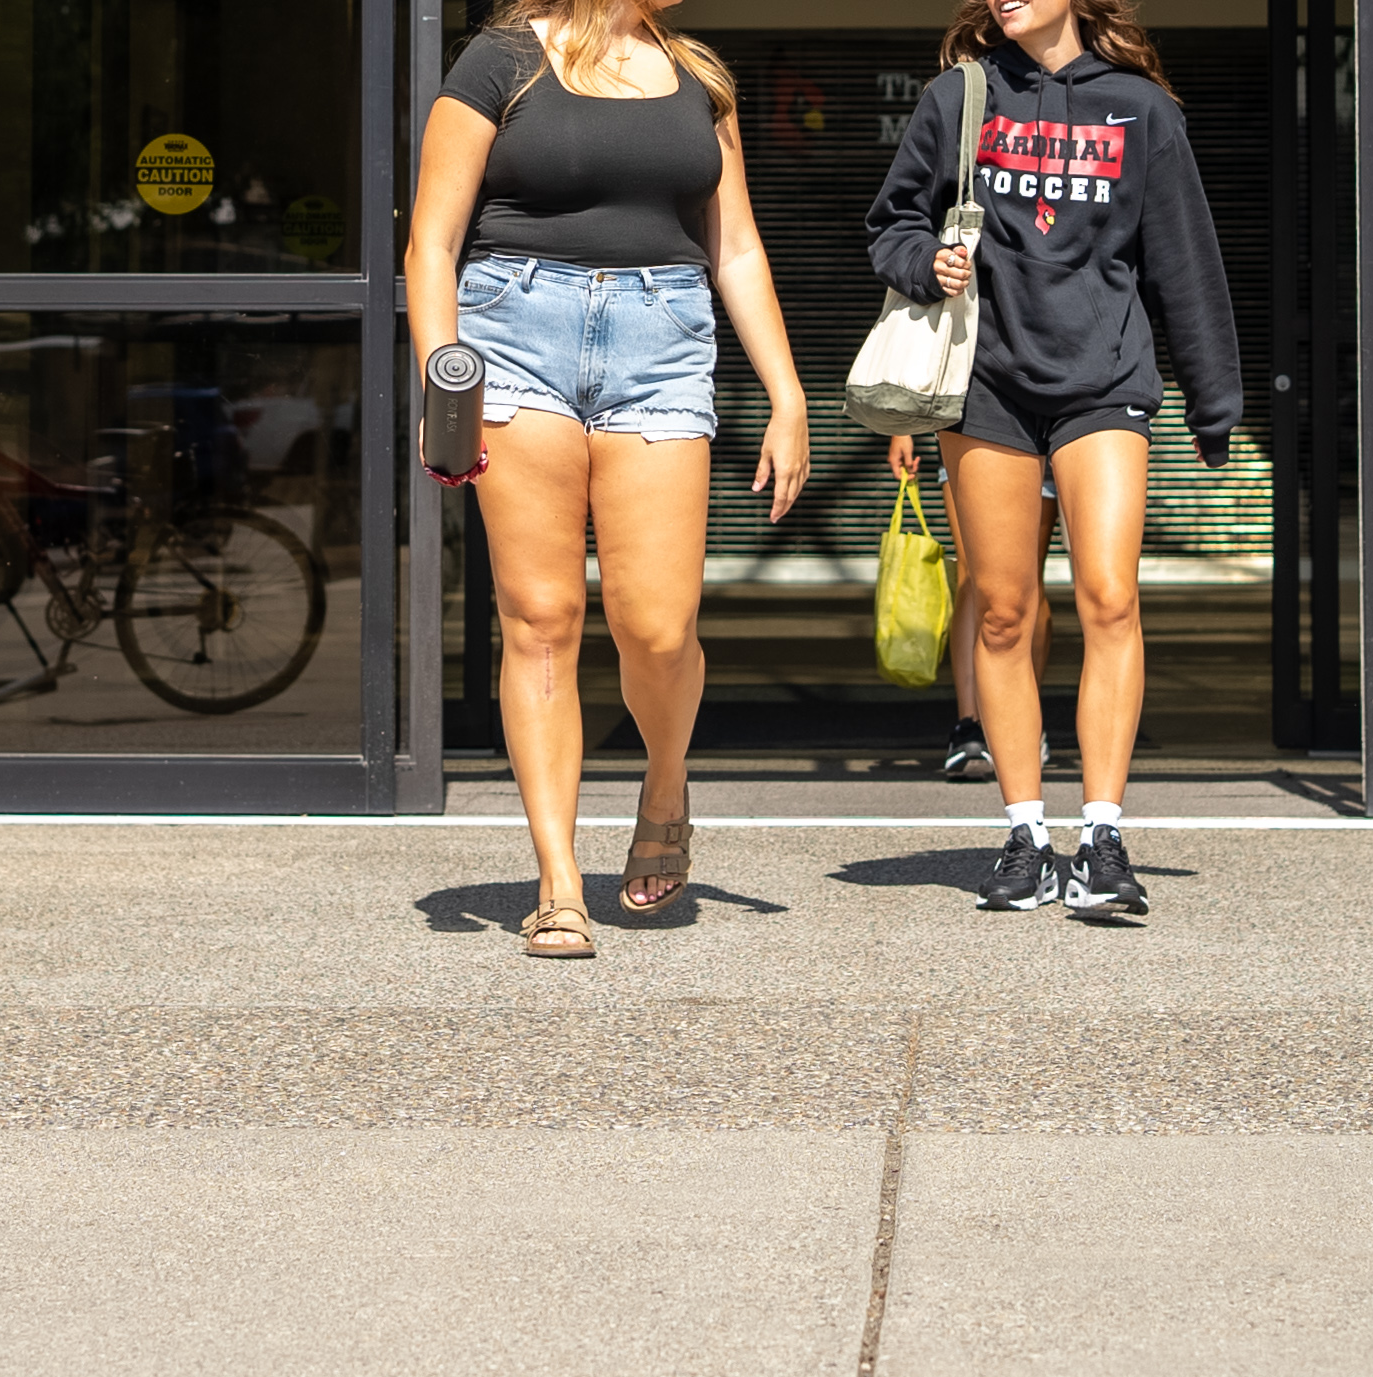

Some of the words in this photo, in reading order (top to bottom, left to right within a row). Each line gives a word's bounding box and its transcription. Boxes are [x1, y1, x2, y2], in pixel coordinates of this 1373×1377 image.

[140, 156, 212, 165] AUTOMATIC
[137, 169, 214, 183] CAUTION
[157, 187, 193, 196] DOOR
